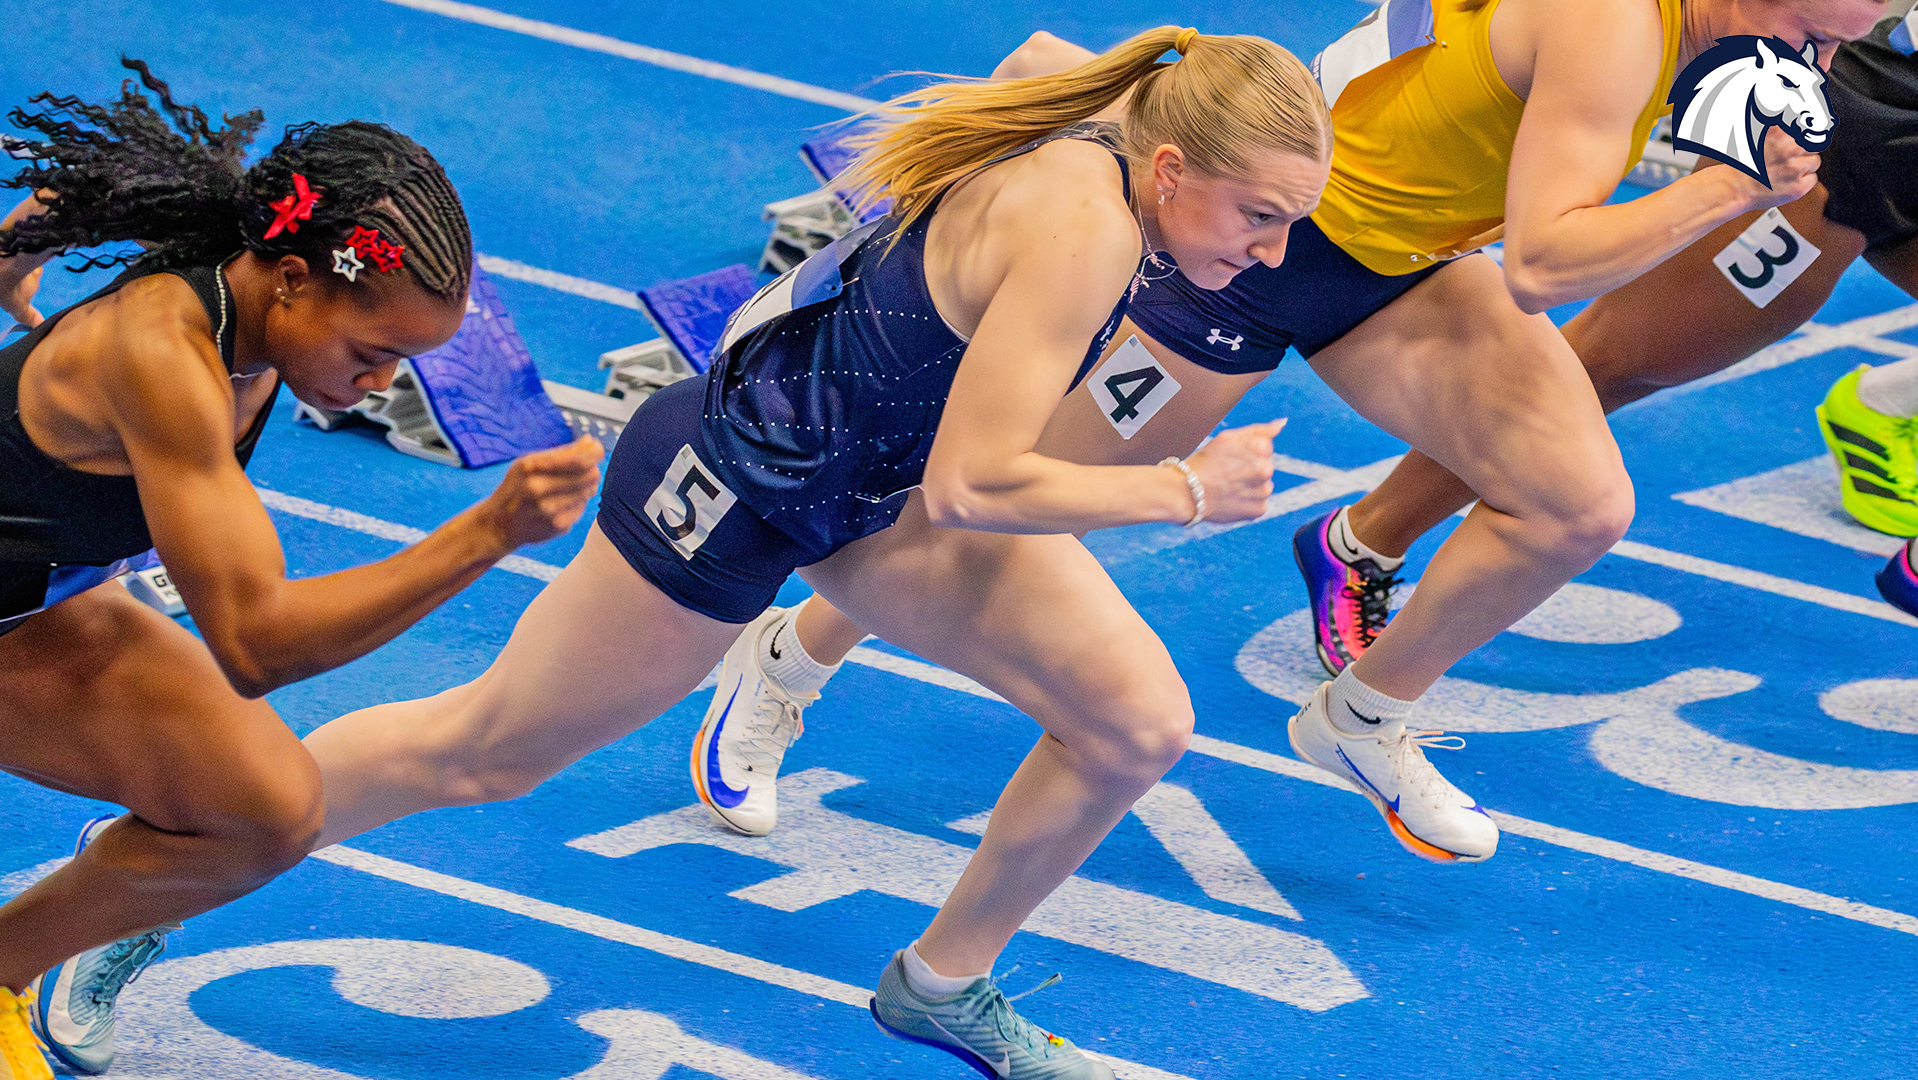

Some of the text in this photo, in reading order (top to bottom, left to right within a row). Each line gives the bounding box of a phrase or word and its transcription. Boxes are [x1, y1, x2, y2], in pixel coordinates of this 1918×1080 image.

[1728, 225, 1799, 289] 3
[1104, 366, 1164, 424] 4
[656, 464, 721, 542] 5
[565, 767, 1371, 1013] 4
